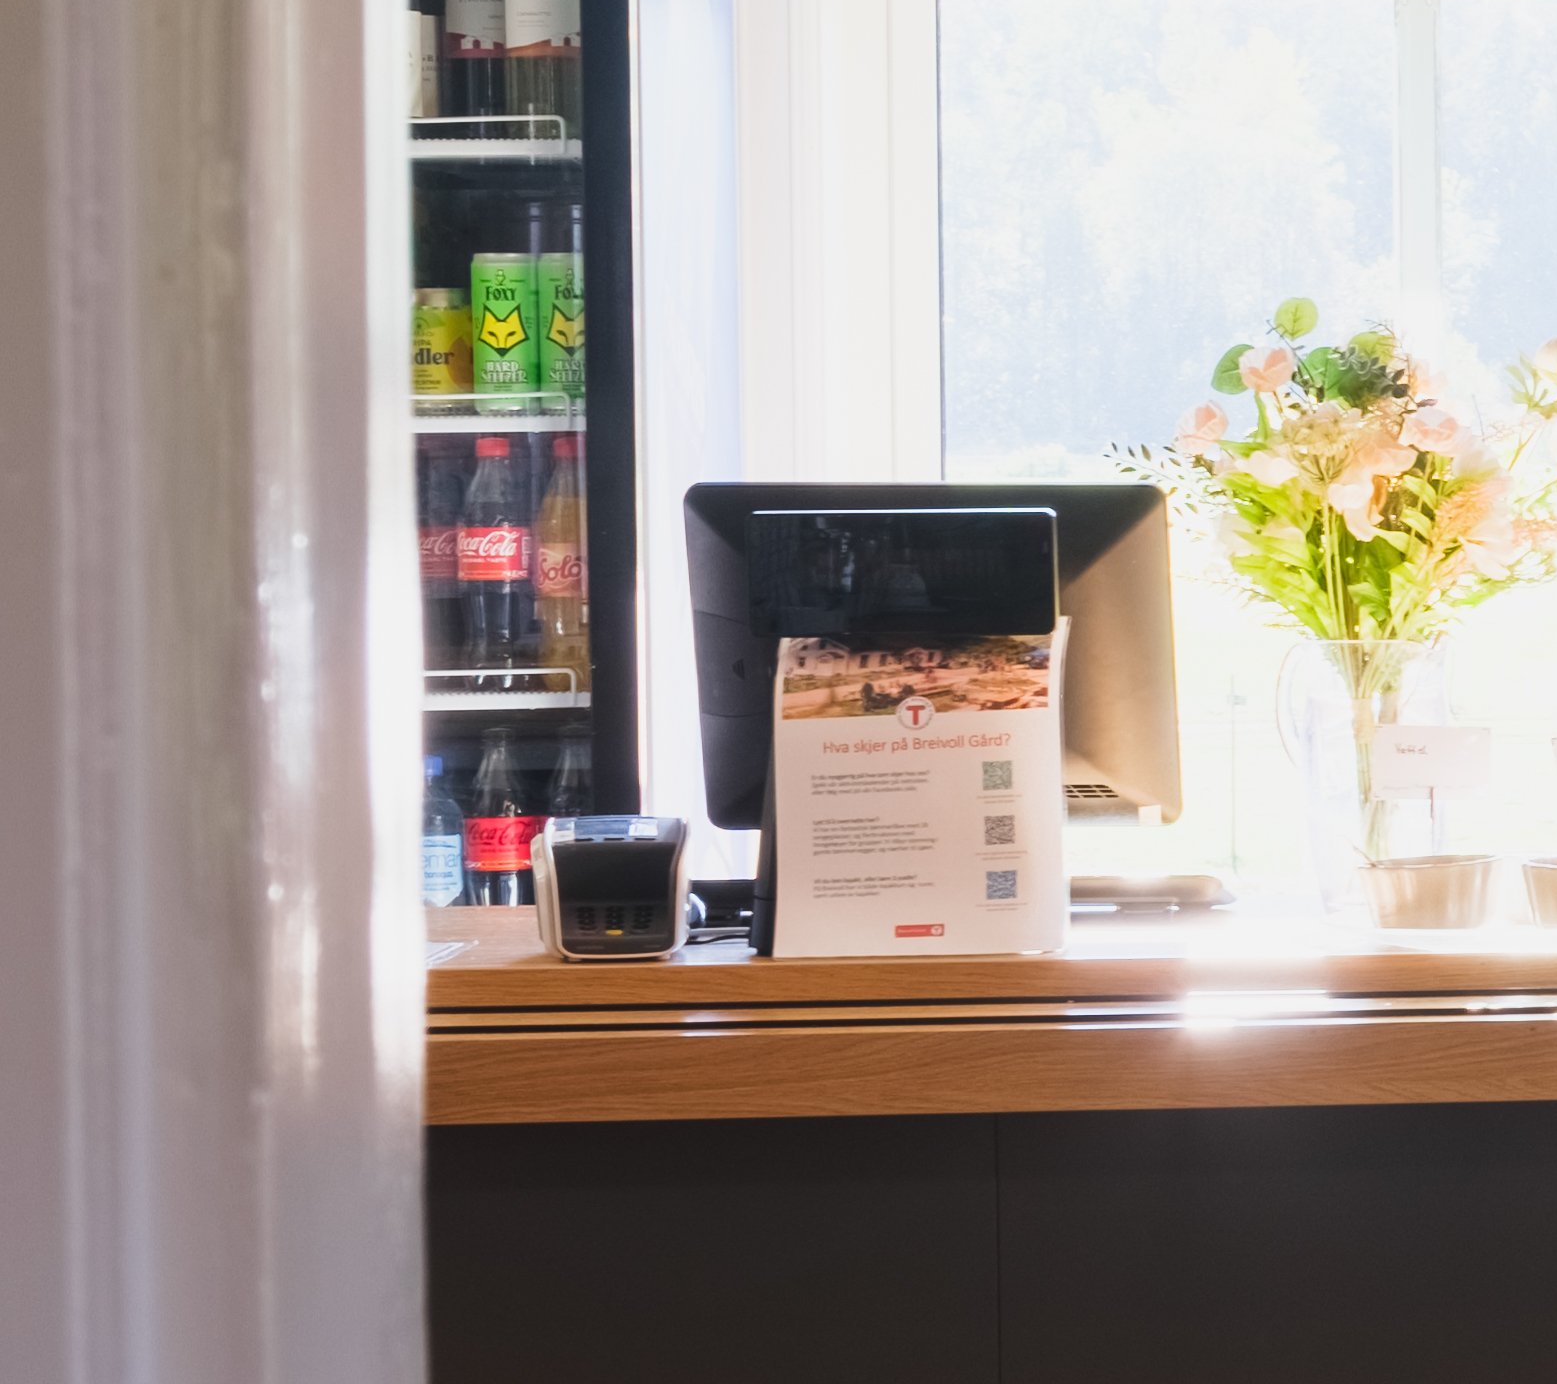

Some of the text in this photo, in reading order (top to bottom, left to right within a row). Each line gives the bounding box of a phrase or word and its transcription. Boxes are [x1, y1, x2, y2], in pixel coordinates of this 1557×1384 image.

[485, 285, 517, 301] FOXY
[485, 359, 521, 372] HARD
[481, 369, 527, 383] SELTZER
[905, 704, 927, 726] T
[822, 732, 1012, 754] Hva skjer på Breivoll Gård?
